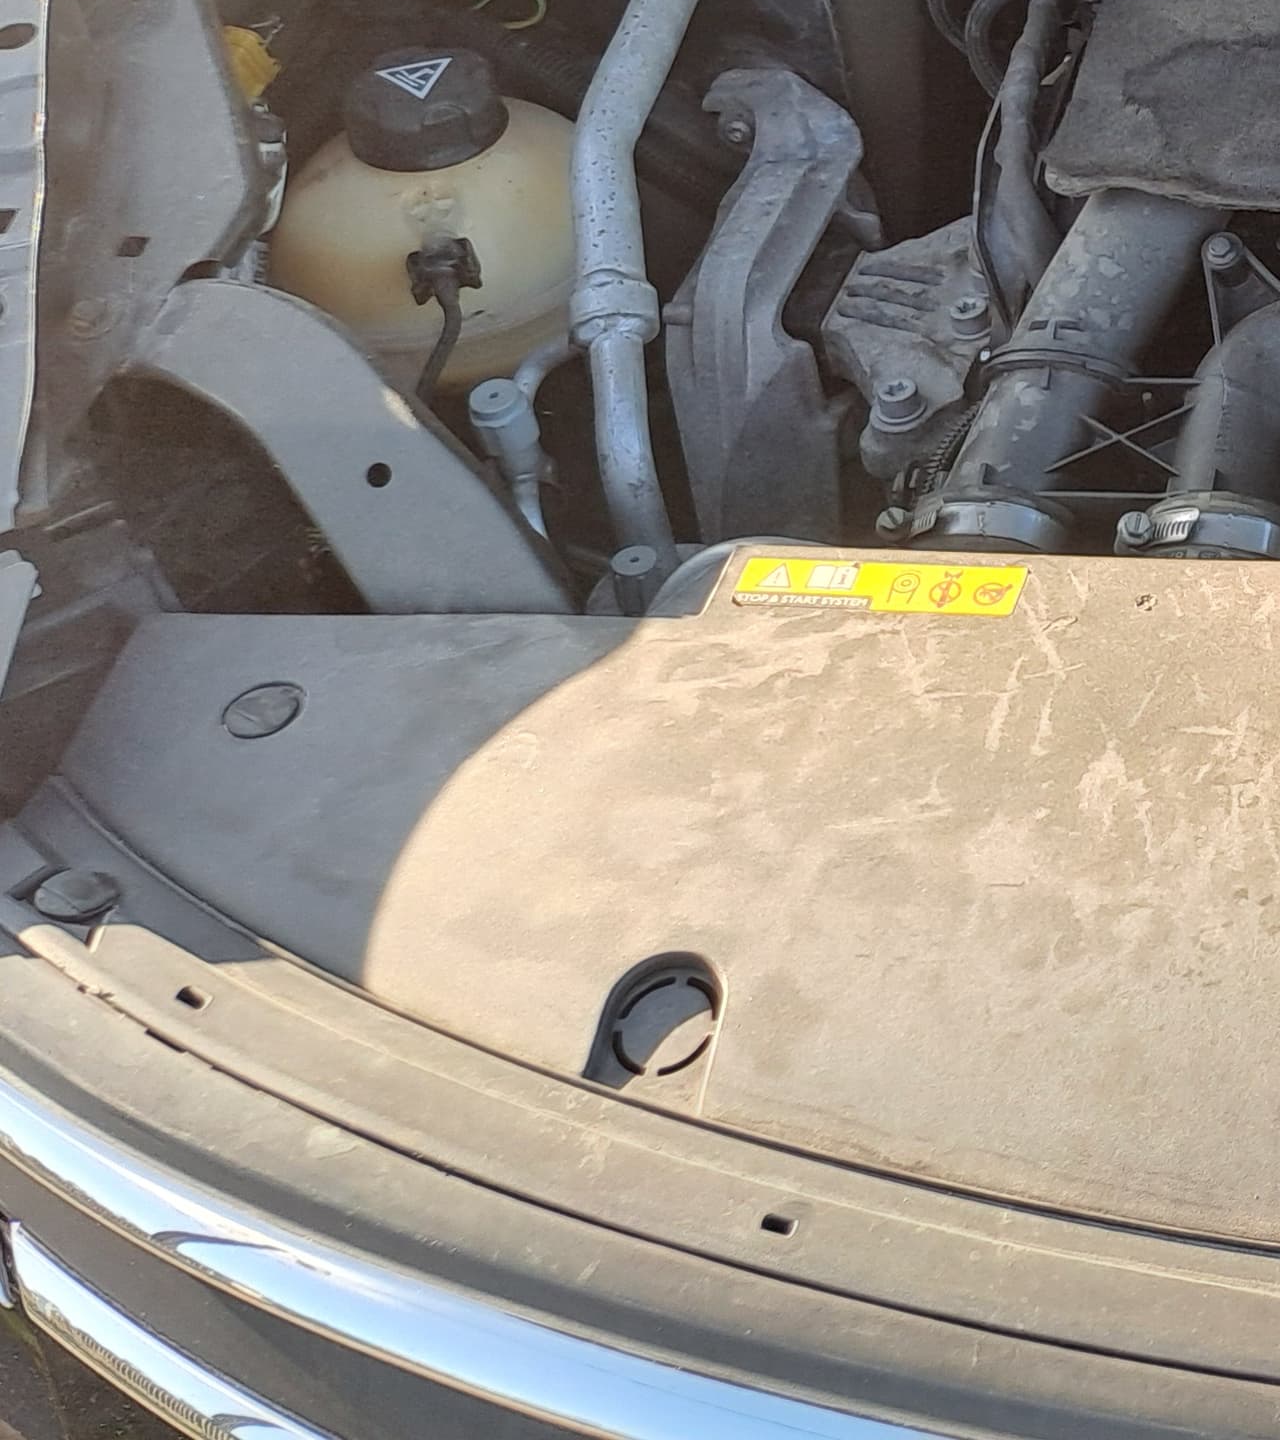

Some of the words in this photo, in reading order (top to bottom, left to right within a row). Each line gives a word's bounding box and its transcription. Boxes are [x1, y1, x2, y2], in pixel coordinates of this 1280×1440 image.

[735, 592, 769, 603] STOP
[780, 595, 818, 604] START
[819, 596, 869, 607] SYSTEM
